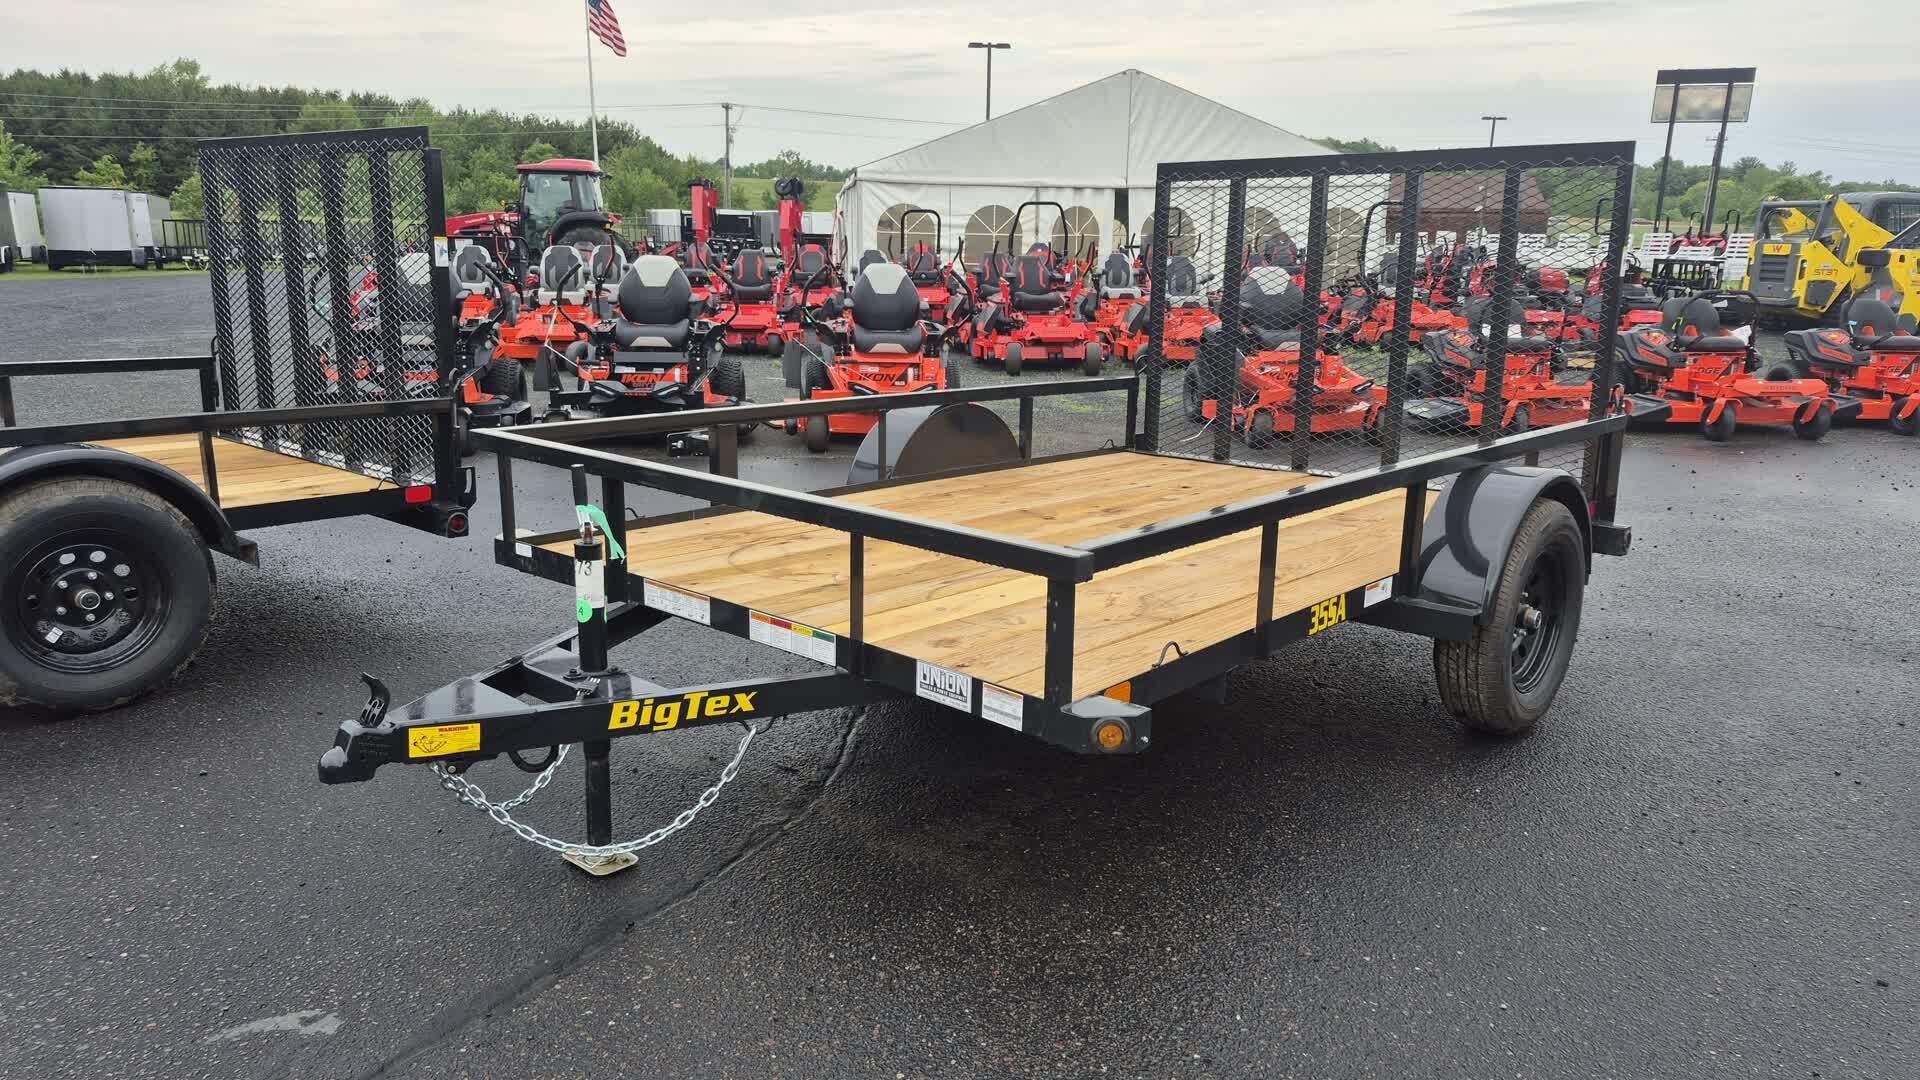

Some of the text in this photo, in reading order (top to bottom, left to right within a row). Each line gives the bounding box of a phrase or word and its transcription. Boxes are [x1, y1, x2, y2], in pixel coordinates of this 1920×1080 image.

[622, 373, 664, 383] IKON
[859, 373, 896, 382] IKON
[608, 691, 758, 731] BigTex
